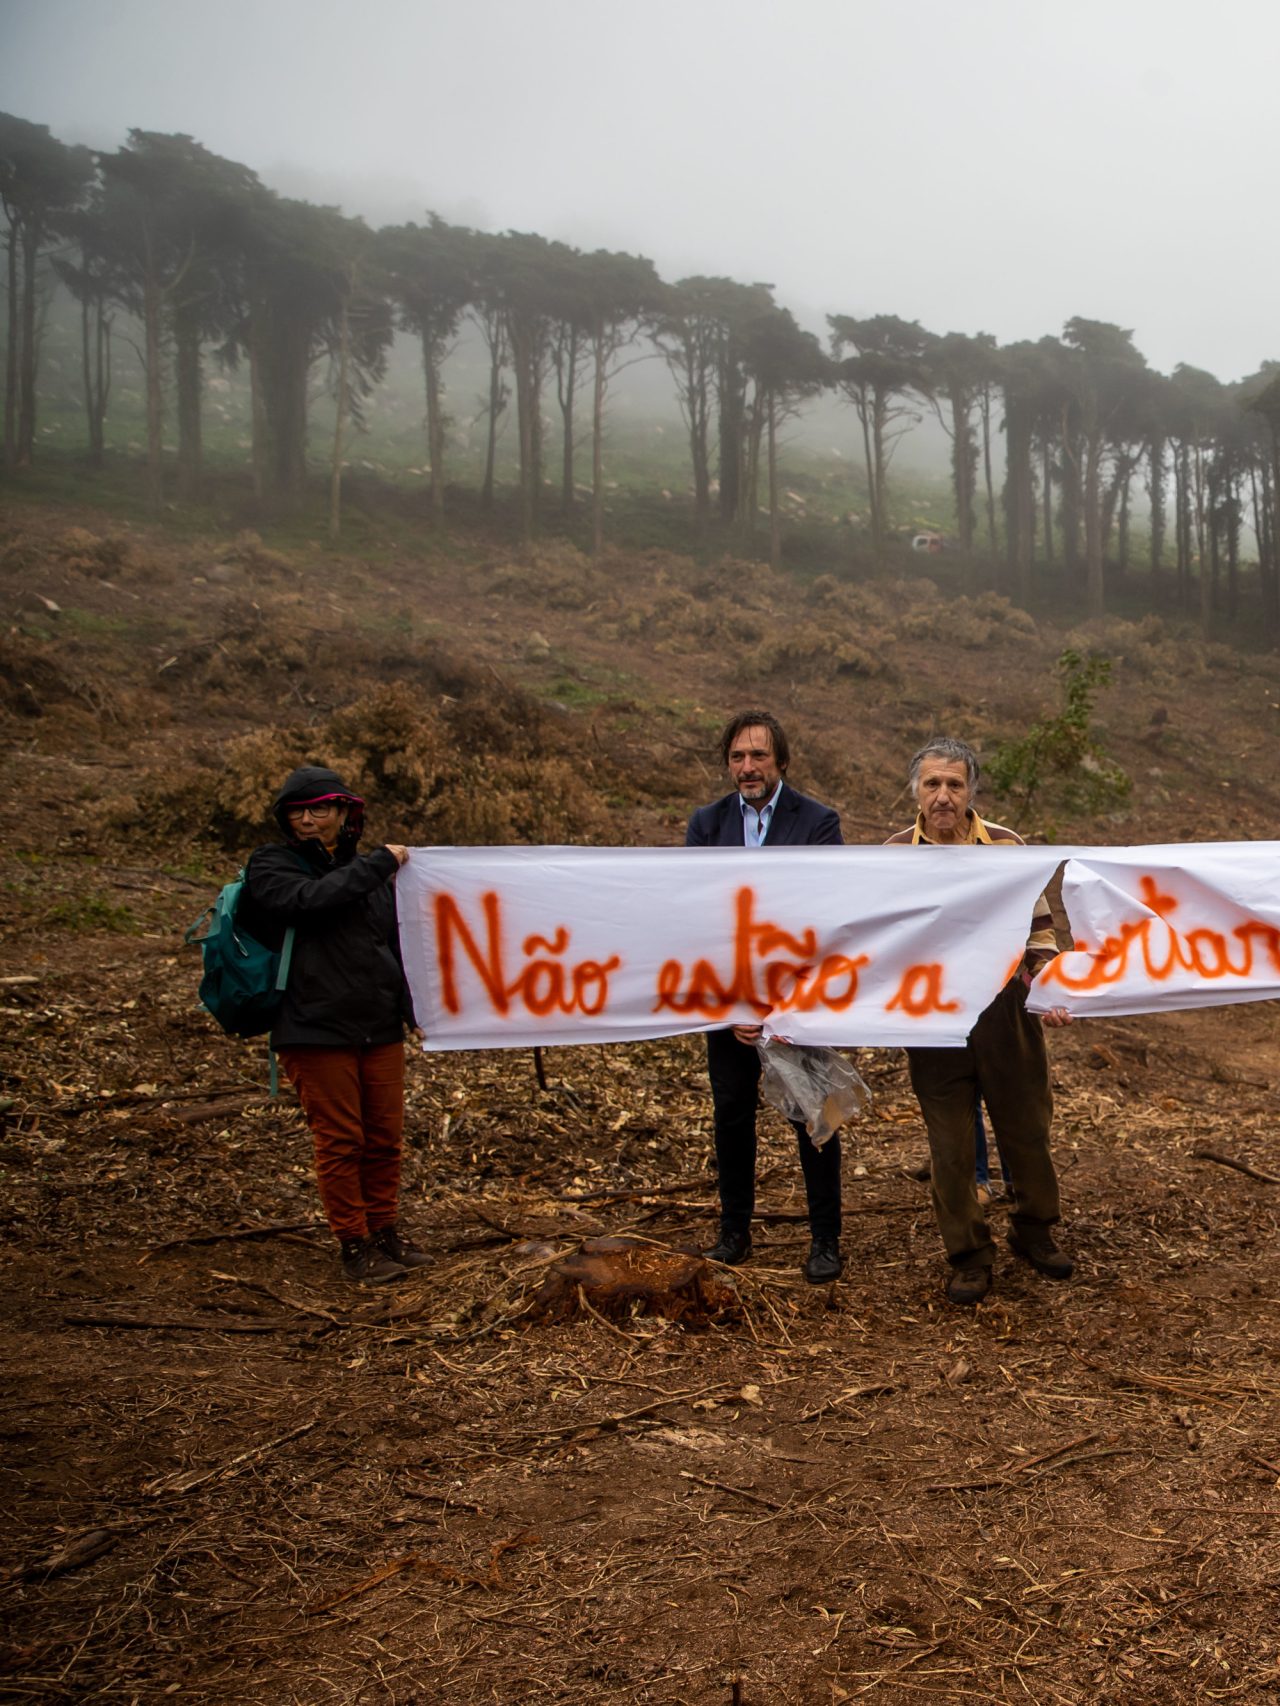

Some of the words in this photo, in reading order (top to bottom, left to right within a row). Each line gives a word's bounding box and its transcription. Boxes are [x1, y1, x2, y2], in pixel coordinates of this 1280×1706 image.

[430, 890, 621, 1018] Não
[651, 885, 869, 1020] estão
[884, 962, 959, 1018] a
